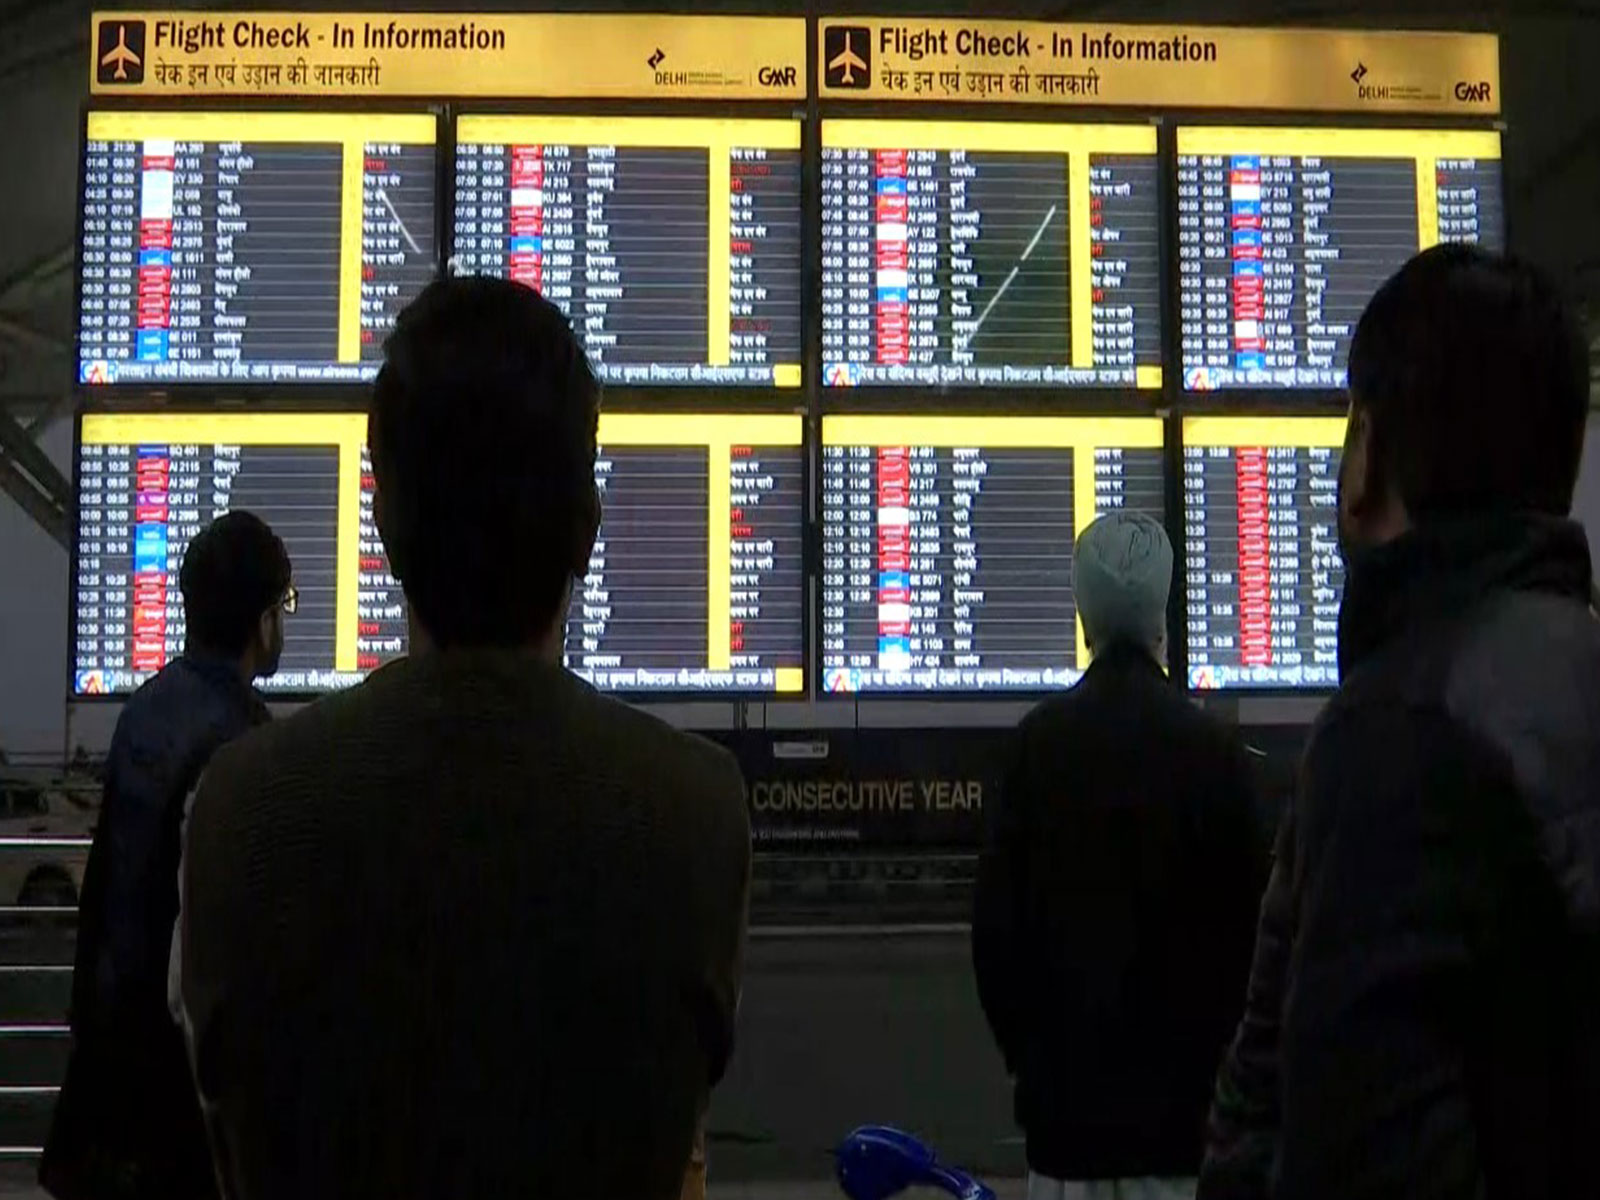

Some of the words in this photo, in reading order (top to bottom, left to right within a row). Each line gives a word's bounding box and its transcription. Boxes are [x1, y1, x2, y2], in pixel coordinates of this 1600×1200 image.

[155, 20, 225, 53] Flight
[233, 21, 309, 48] Check
[332, 22, 355, 48] In
[364, 22, 505, 50] Information
[881, 28, 947, 60] Flight
[956, 29, 1029, 56] Check
[1053, 32, 1073, 58] In
[1081, 33, 1217, 62] Information
[155, 57, 182, 84] चेक
[189, 64, 209, 87] इन
[215, 62, 236, 86] एवं
[245, 64, 281, 90] उड़ान
[287, 58, 308, 85] की
[316, 58, 381, 85] जानकारी
[655, 72, 687, 85] DELHI
[882, 64, 909, 90] चेक
[915, 70, 935, 93] इन
[940, 67, 961, 94] एवं
[966, 71, 1004, 97] उड़ान
[1009, 66, 1031, 94] की
[1036, 67, 1100, 96] जानकारी
[1358, 85, 1389, 99] DELHI
[752, 781, 913, 811] CONSECUTIVE
[922, 781, 982, 811] YEAR
